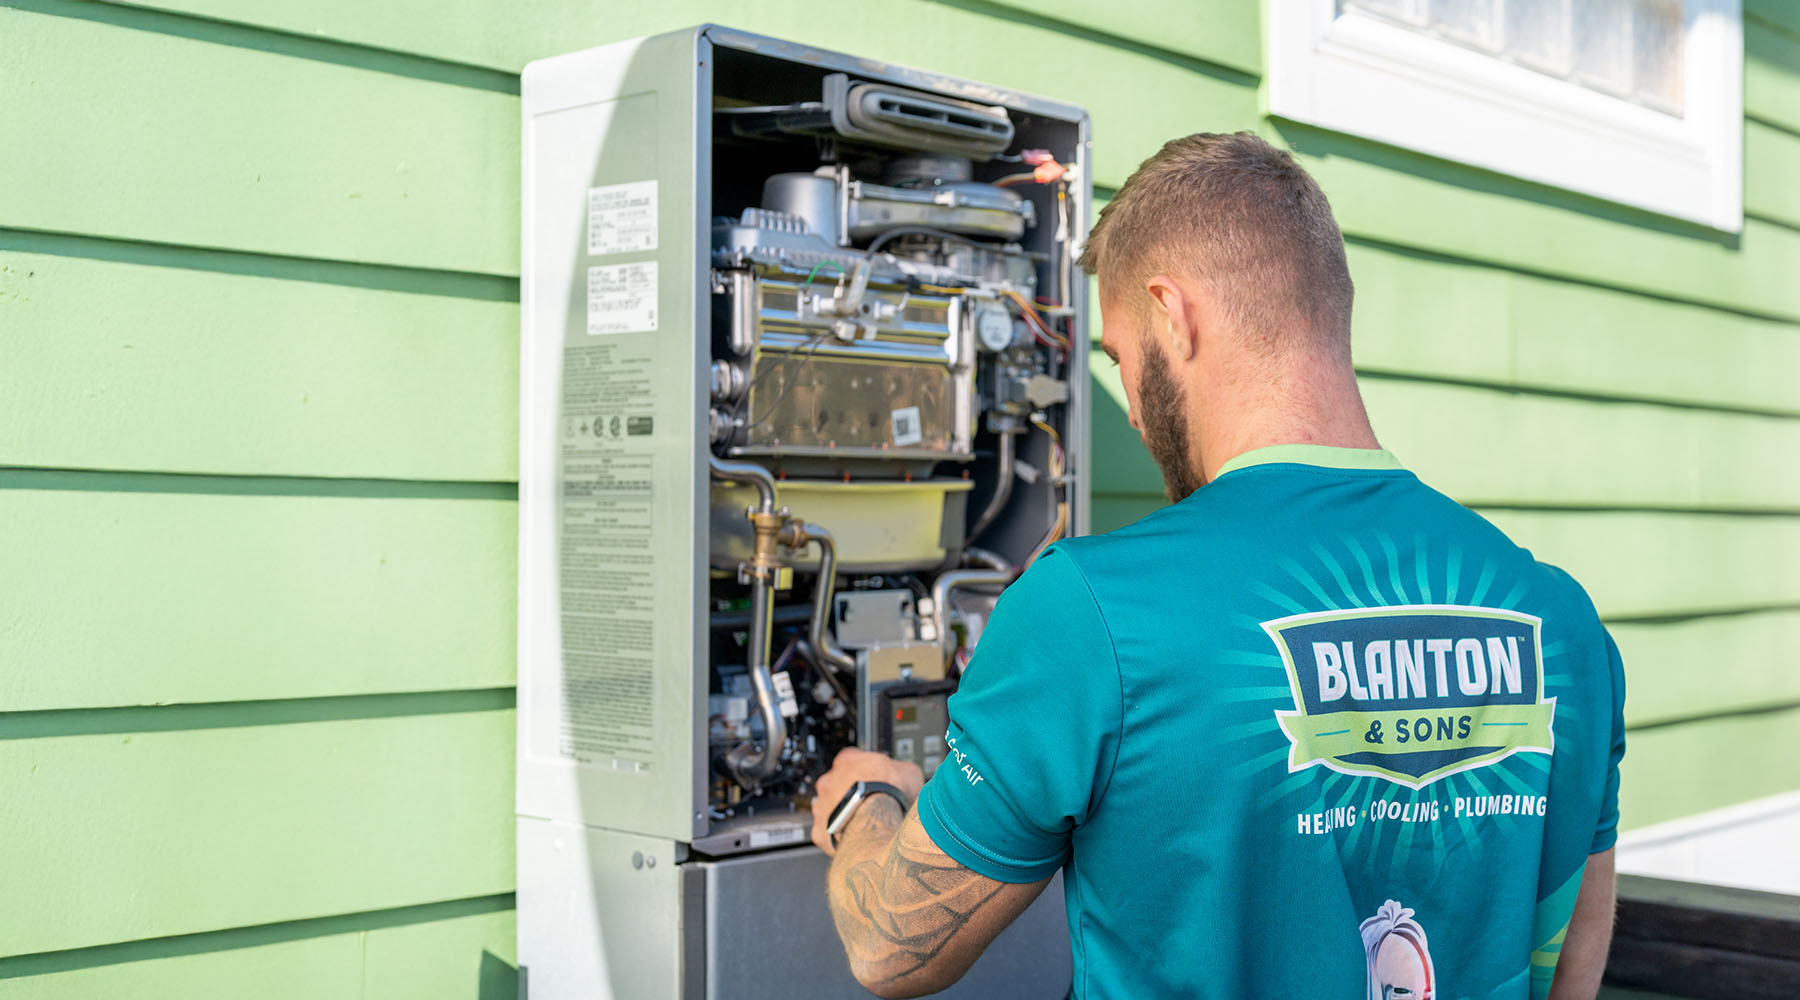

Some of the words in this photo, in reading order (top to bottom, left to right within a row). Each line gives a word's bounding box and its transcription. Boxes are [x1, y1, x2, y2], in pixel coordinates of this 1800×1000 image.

[1311, 637, 1523, 703] BLANTON
[1364, 719, 1385, 745] &
[1395, 715, 1473, 744] SONS
[1297, 805, 1357, 835] HEAING
[1369, 799, 1440, 823] COOLING
[1454, 794, 1548, 818] PLUMBING
